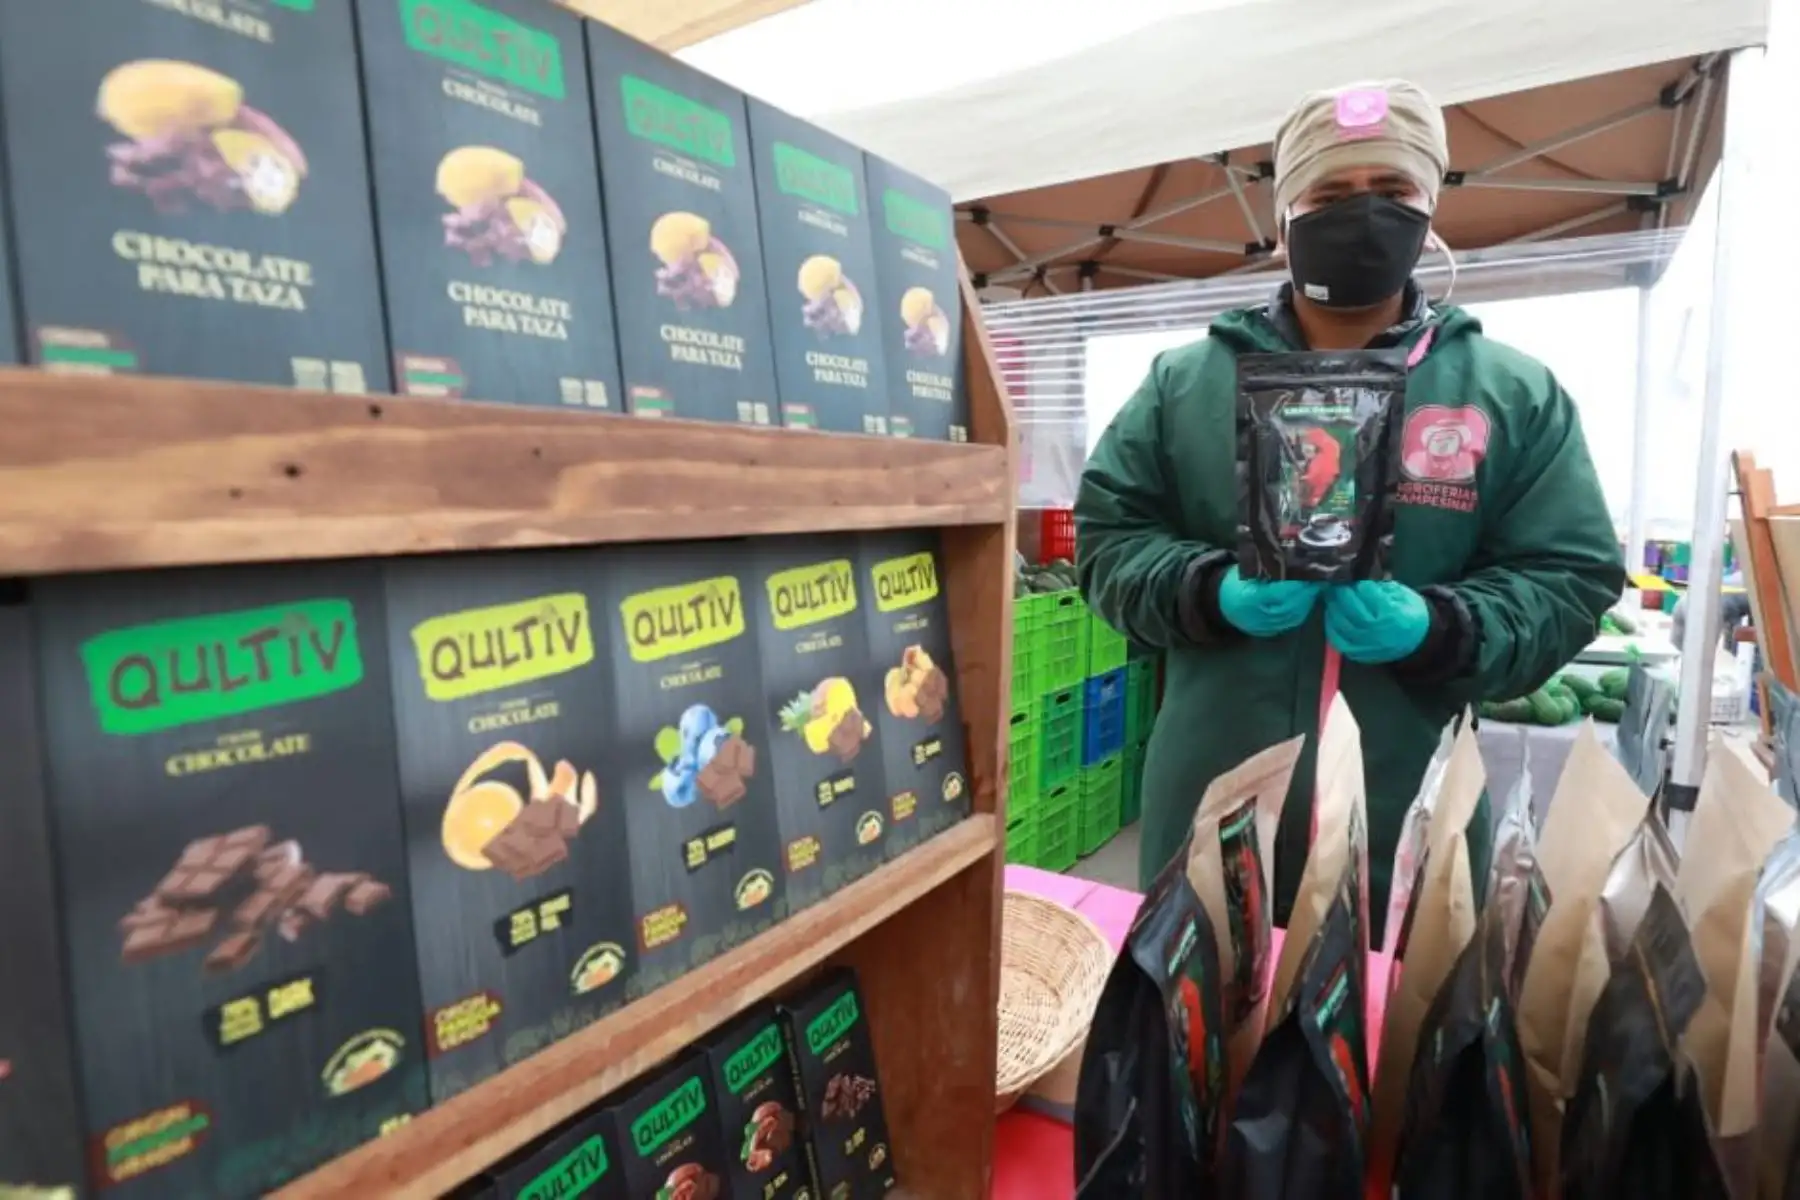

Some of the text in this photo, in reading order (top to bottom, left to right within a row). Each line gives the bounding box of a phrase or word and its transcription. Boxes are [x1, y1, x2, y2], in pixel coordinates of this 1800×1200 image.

[111, 229, 313, 286] CHOCOLATE
[137, 261, 306, 312] PARA TAZA
[447, 280, 572, 320] CHOCOLATE
[463, 305, 568, 341] PARA TAZA
[660, 324, 746, 353] CHOCOLATE
[671, 345, 742, 371] PARA TAZA
[806, 351, 869, 374] CHOCOLATE
[775, 570, 850, 618] QULTIV
[878, 561, 933, 601] QULTIV
[633, 591, 736, 647] QULTIV
[109, 618, 346, 710] QULTIV
[430, 611, 580, 681] QULTIV
[468, 701, 560, 733] CHOCOLATE
[729, 1031, 778, 1085] QULTIV
[639, 1083, 700, 1146] QULTIV
